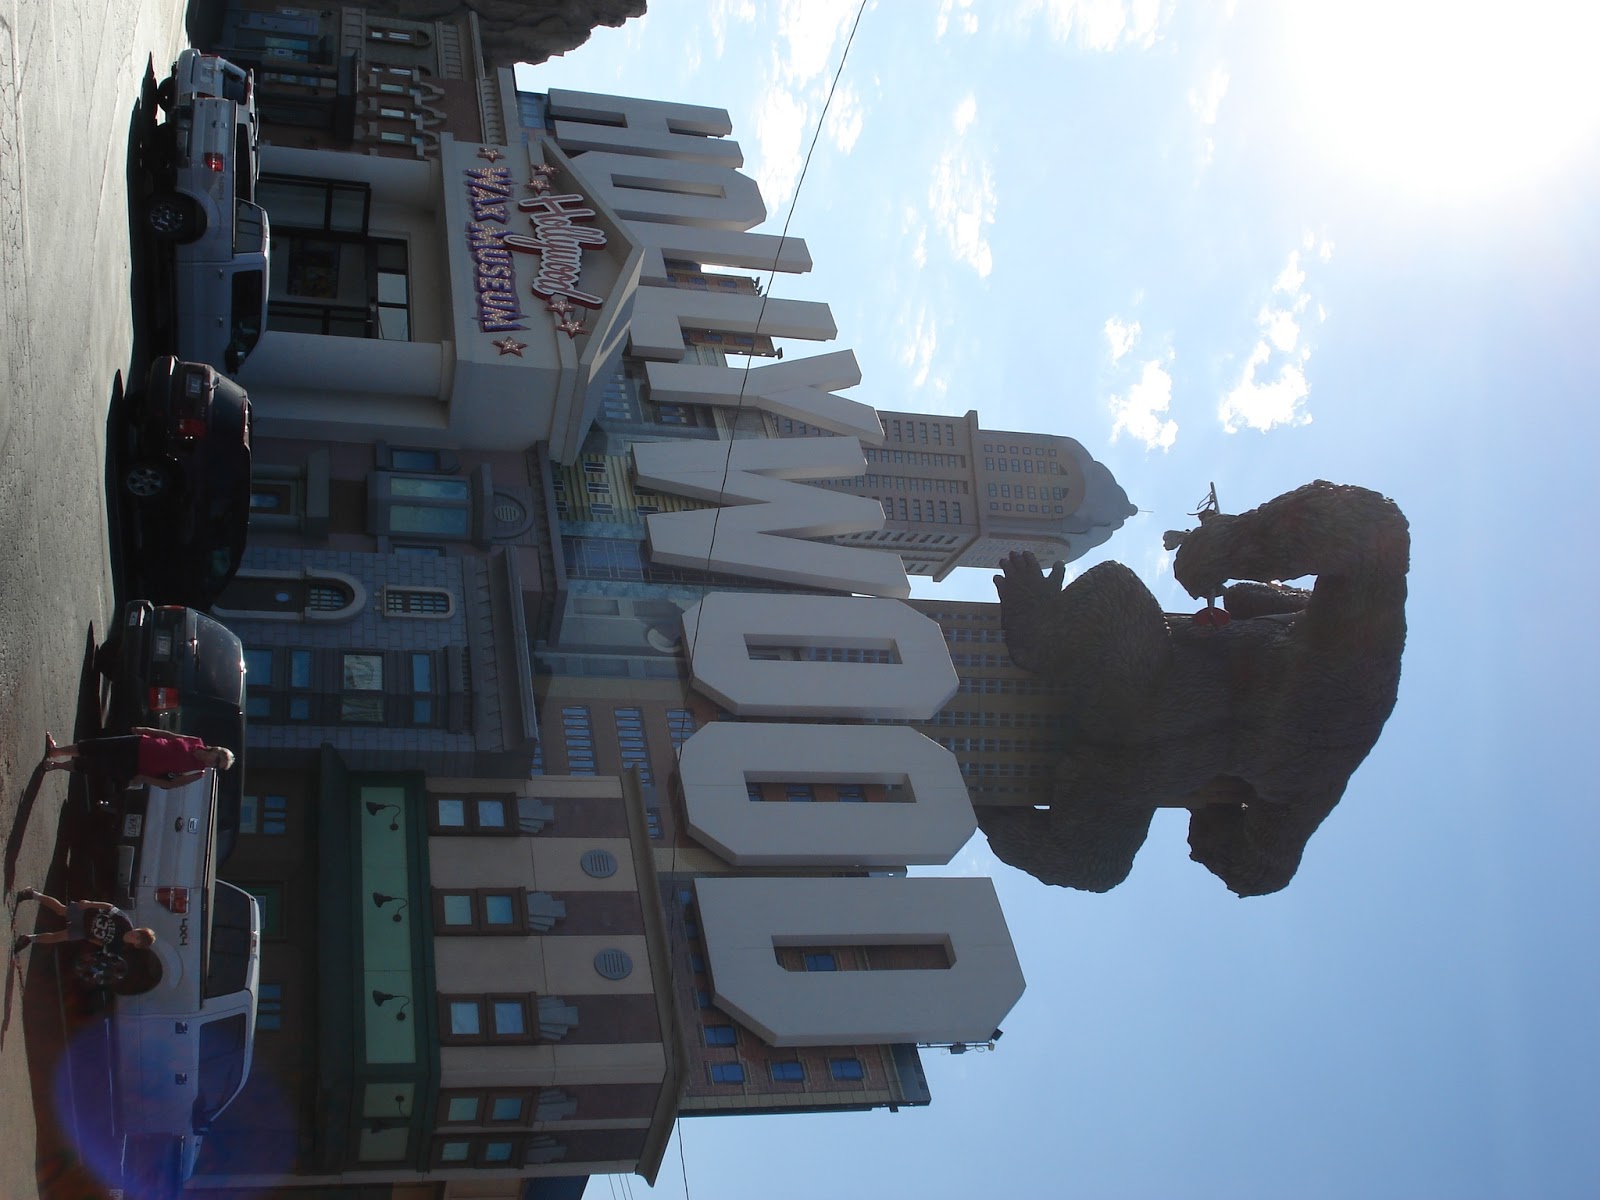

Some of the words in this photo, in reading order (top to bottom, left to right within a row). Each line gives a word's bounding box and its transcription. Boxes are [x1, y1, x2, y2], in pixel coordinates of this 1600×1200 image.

[463, 168, 517, 224] WAX
[503, 193, 607, 309] Hollywood
[466, 222, 530, 333] MUSEUM
[548, 90, 1025, 1047] HOLLYWOOD
[93, 918, 109, 939] 33
